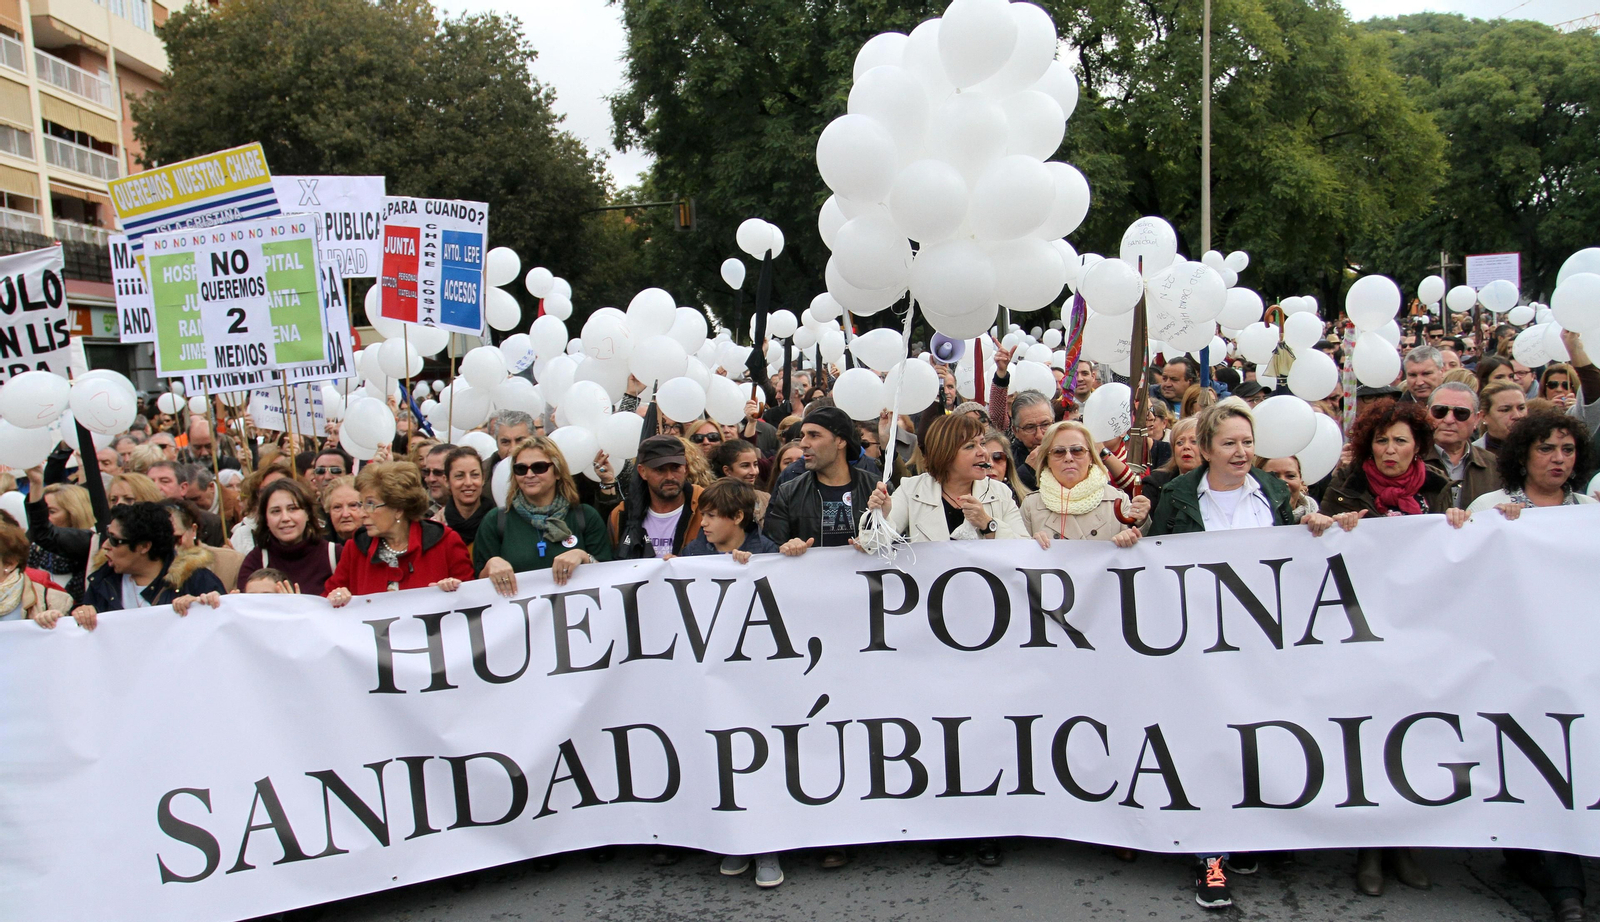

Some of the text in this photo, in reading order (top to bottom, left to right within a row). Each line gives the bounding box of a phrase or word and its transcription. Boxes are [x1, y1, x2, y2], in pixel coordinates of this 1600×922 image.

[113, 149, 265, 211] QUEREMOS NUESTRO CHARE
[298, 179, 321, 206] X
[186, 207, 244, 230] CRISTINA
[425, 201, 485, 225] CUANDO?
[155, 223, 306, 250] NO NO NO NO NO NO NO NO
[384, 236, 416, 256] JUNTA
[425, 223, 437, 267] CHARE
[211, 249, 249, 277] NO
[464, 245, 480, 263] LEPE
[201, 276, 265, 302] QUEREMOS
[444, 279, 477, 305] ACCESOS
[227, 308, 248, 334] 2
[215, 342, 268, 368] MEDIOS
[256, 390, 270, 398] POR
[362, 552, 1384, 694] HUELVA, POR UNA
[156, 693, 1600, 885] SANIDAD PÚBLICA DIGN
